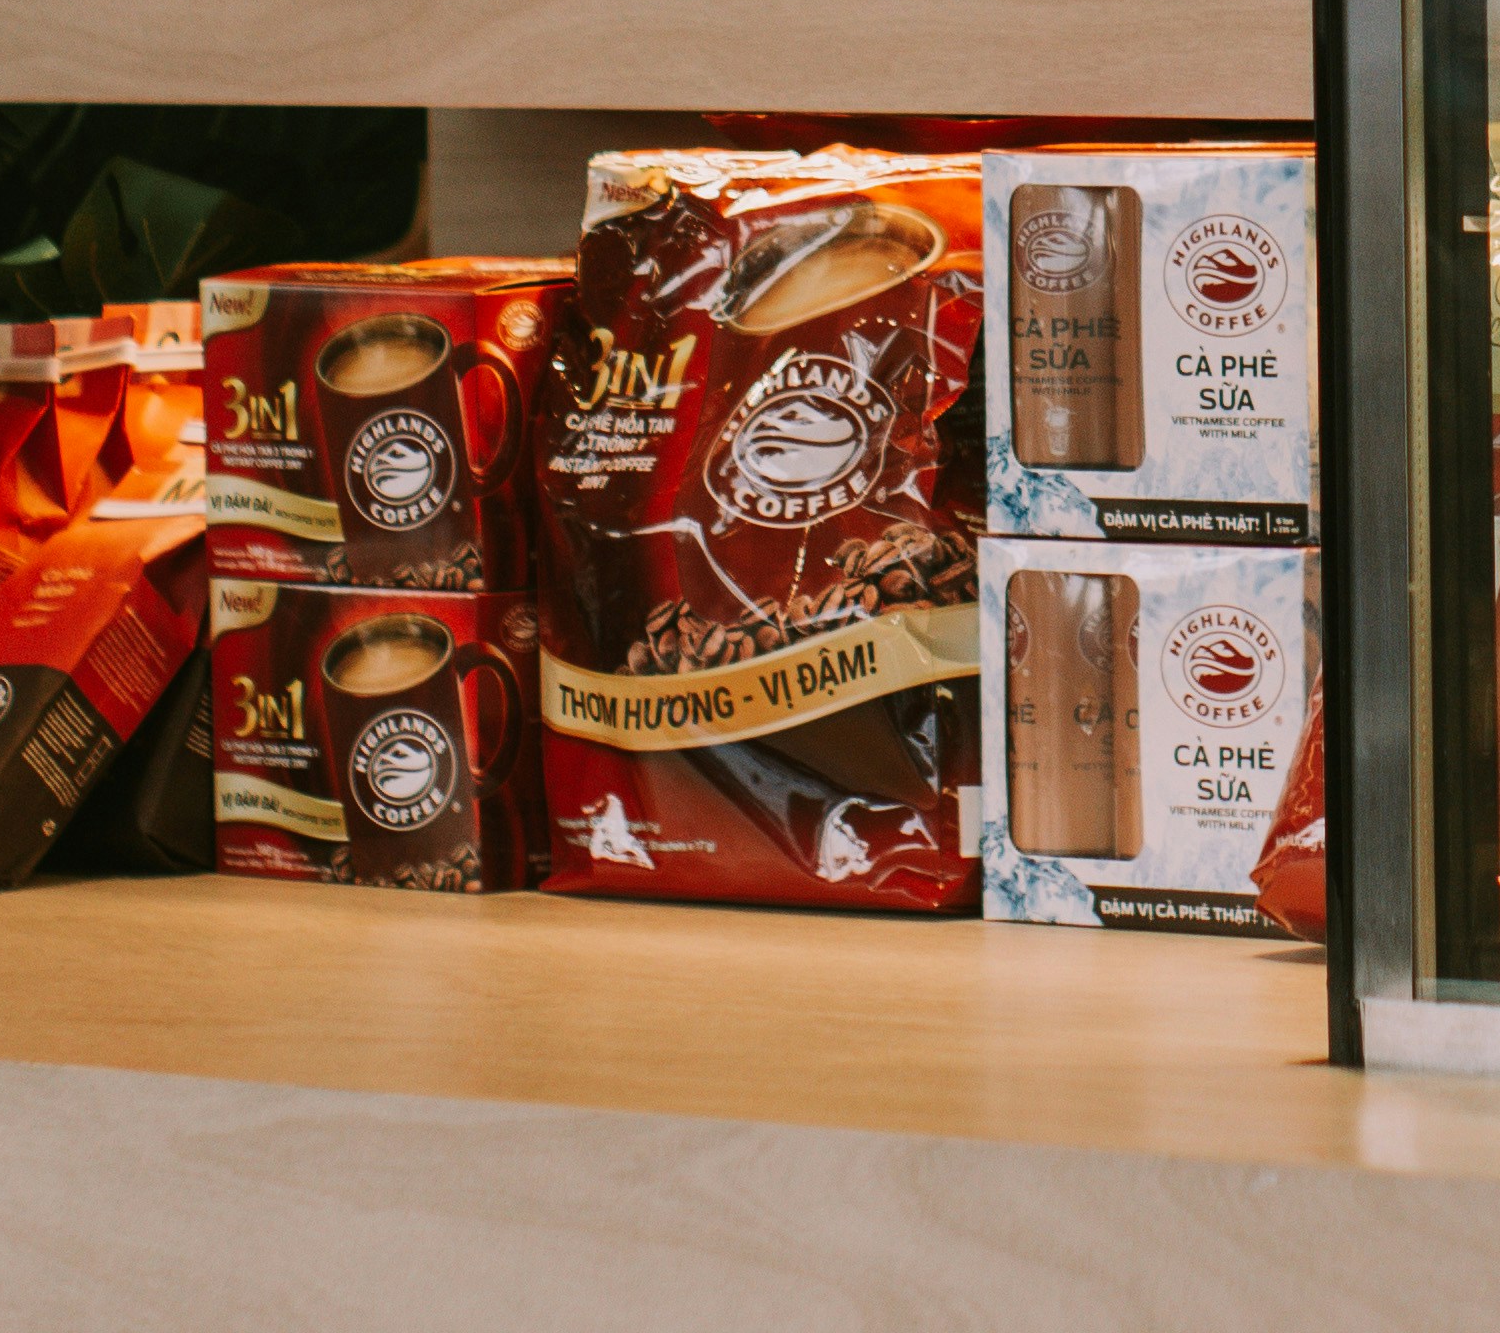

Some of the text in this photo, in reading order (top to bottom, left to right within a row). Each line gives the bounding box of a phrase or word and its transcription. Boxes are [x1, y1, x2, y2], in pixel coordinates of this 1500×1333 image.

[1172, 221, 1280, 270] HIGHLANDS
[208, 291, 253, 317] New!
[1185, 302, 1268, 331] COFFEE
[1029, 342, 1091, 371] SỮA
[1176, 346, 1279, 378] CÀ PHÊ
[1199, 381, 1255, 411] SỮA
[648, 415, 675, 434] TAN
[1171, 415, 1286, 428] VIETNAMESE COFFEE
[1199, 429, 1258, 440] WITH MILK
[351, 416, 445, 474] HIGHLANDS
[370, 486, 443, 524] COFFEE
[734, 469, 868, 520] COFFEE
[1158, 509, 1180, 529] CÀ
[219, 589, 263, 614] New!
[1170, 612, 1276, 661] HIGHLANDS
[559, 641, 878, 731] THƠM HƯƠNG VỊ ĐẬM!
[1183, 693, 1264, 721] COFFEE
[355, 715, 446, 774] HIGHLANDS
[1174, 735, 1275, 770] CÀ PHÊ
[1197, 772, 1252, 803] SỮA
[373, 787, 445, 824] COFFEE
[1169, 805, 1237, 818] VIETNAMESE
[1197, 819, 1255, 831] WITH MILK
[1155, 899, 1177, 919] CÀ
